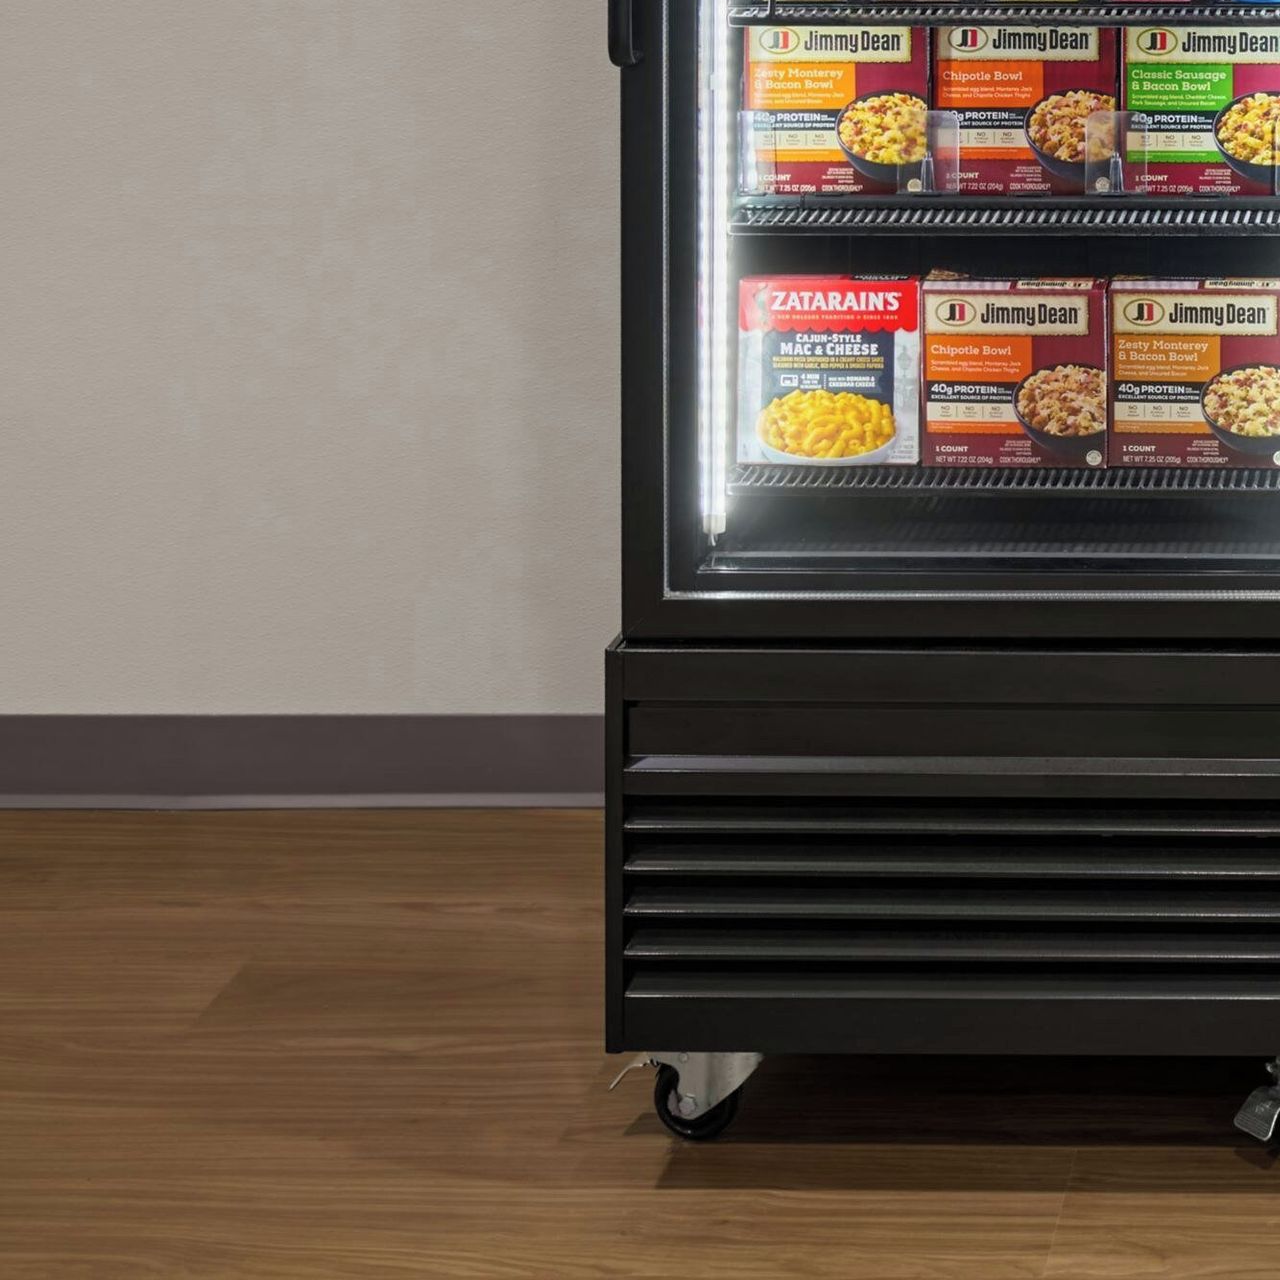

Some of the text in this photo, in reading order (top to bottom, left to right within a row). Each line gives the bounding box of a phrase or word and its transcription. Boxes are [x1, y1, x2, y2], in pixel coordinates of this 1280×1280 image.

[804, 30, 900, 53] Jimmy Dean
[993, 28, 1089, 52] Jimmy Dean
[1182, 32, 1278, 54] Jimmy Dean
[943, 70, 1023, 82] Chipotle Bowl
[1132, 70, 1226, 82] Classic Sausage
[1144, 174, 1168, 182] COUNT
[771, 292, 899, 311] ZATARAIN'S
[981, 303, 1077, 325] Jimmy Dean
[1169, 303, 1266, 326] Jimmy Dean
[796, 334, 861, 342] CAJUN-STYLE
[781, 343, 878, 355] MAC & CHEESE
[931, 344, 1011, 356] Chipotle Bowl
[1118, 340, 1208, 352] Zesty Monterey
